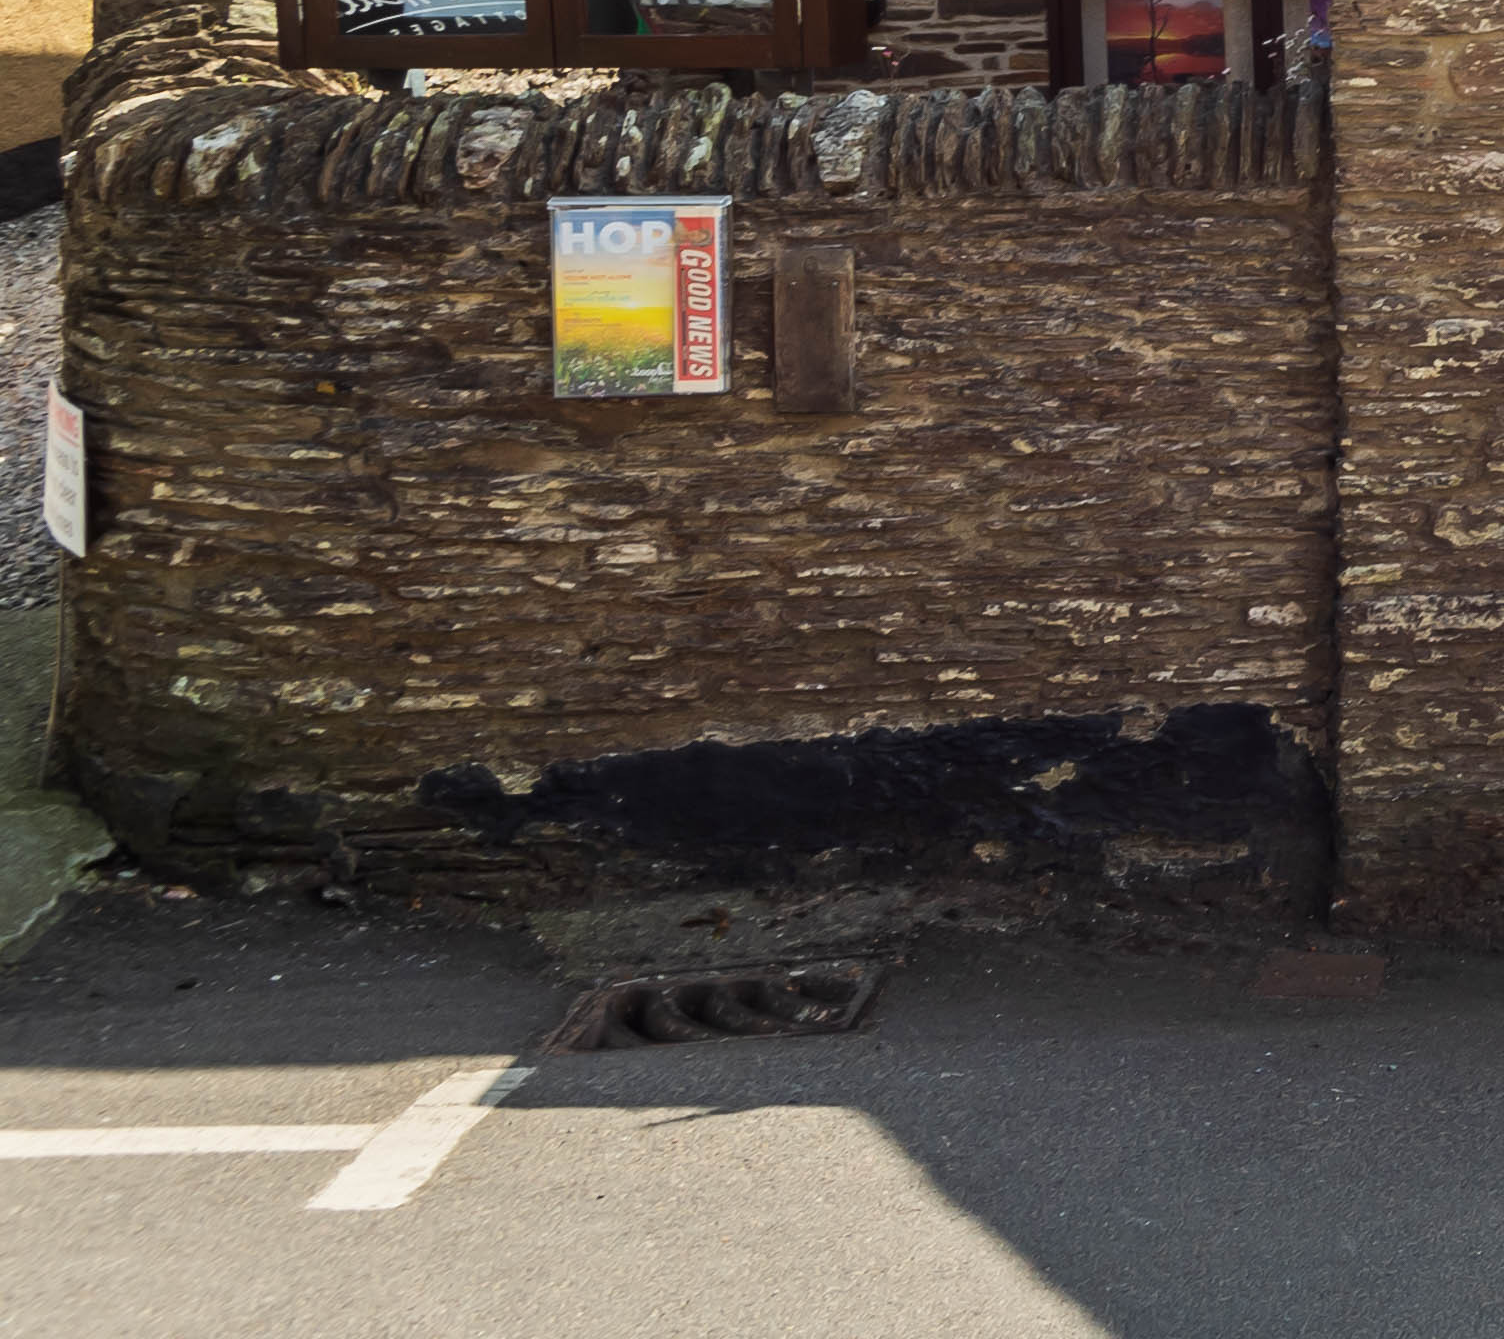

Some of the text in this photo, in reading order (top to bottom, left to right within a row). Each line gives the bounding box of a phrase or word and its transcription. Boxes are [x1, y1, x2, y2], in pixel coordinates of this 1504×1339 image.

[560, 221, 673, 255] HOP
[680, 249, 713, 378] GOOD NEWS
